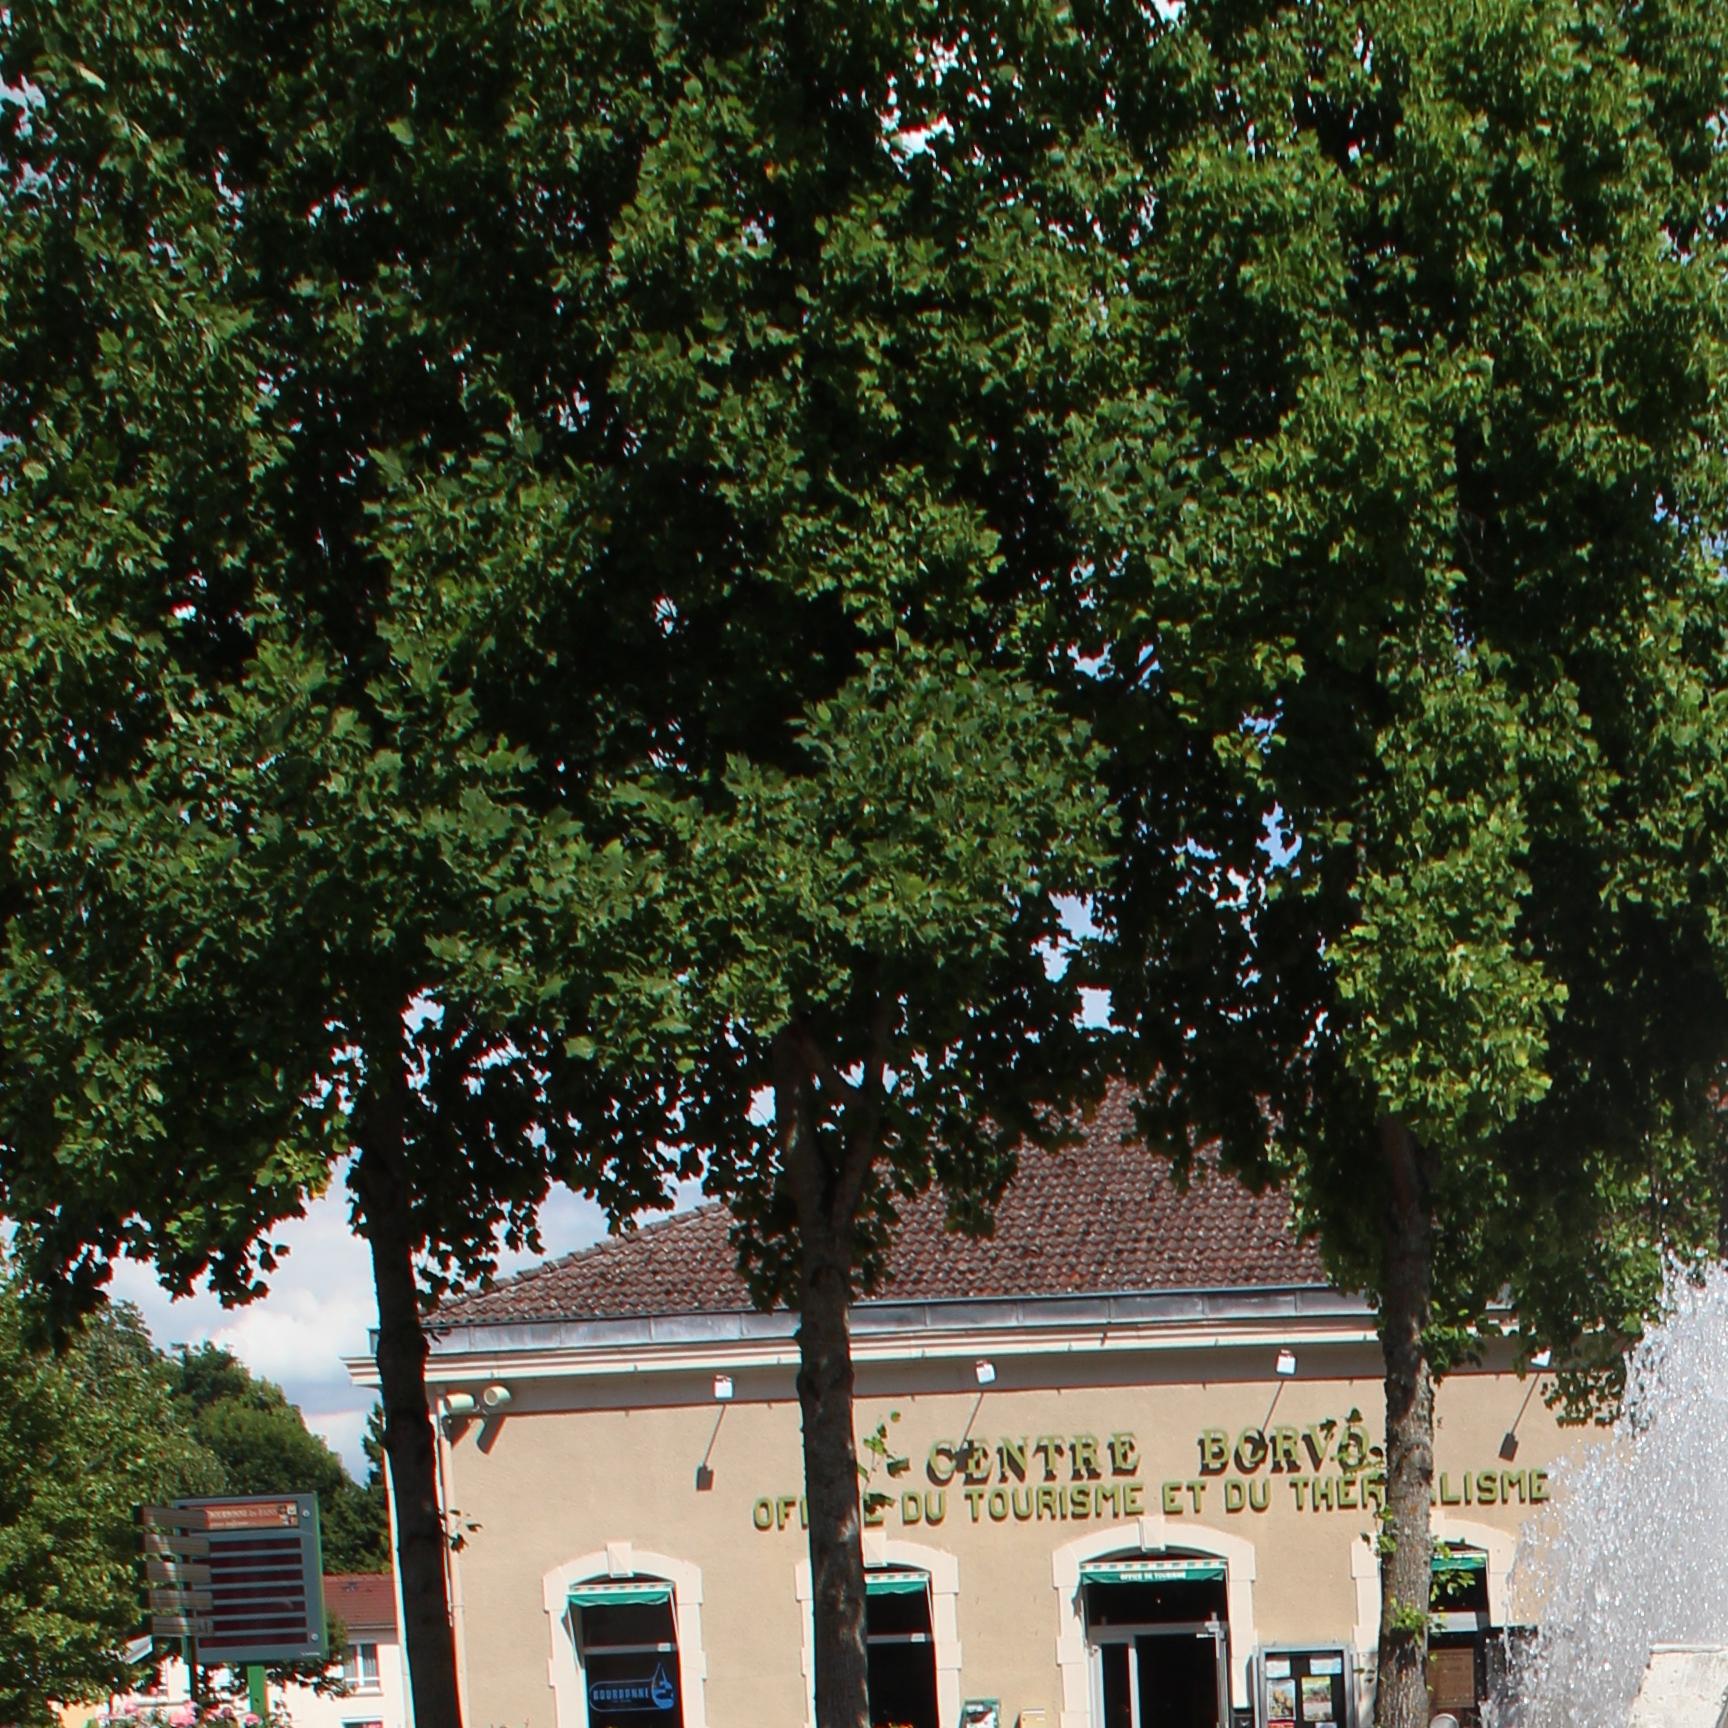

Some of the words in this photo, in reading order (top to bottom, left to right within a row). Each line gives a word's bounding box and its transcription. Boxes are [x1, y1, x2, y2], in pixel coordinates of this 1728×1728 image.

[925, 1431, 1142, 1487] CENTRE
[1198, 1422, 1371, 1478] BORVO
[902, 1490, 947, 1527] DU
[963, 1482, 1145, 1522] TOURISME
[1162, 1480, 1206, 1515] ET
[1224, 1476, 1274, 1514] DU
